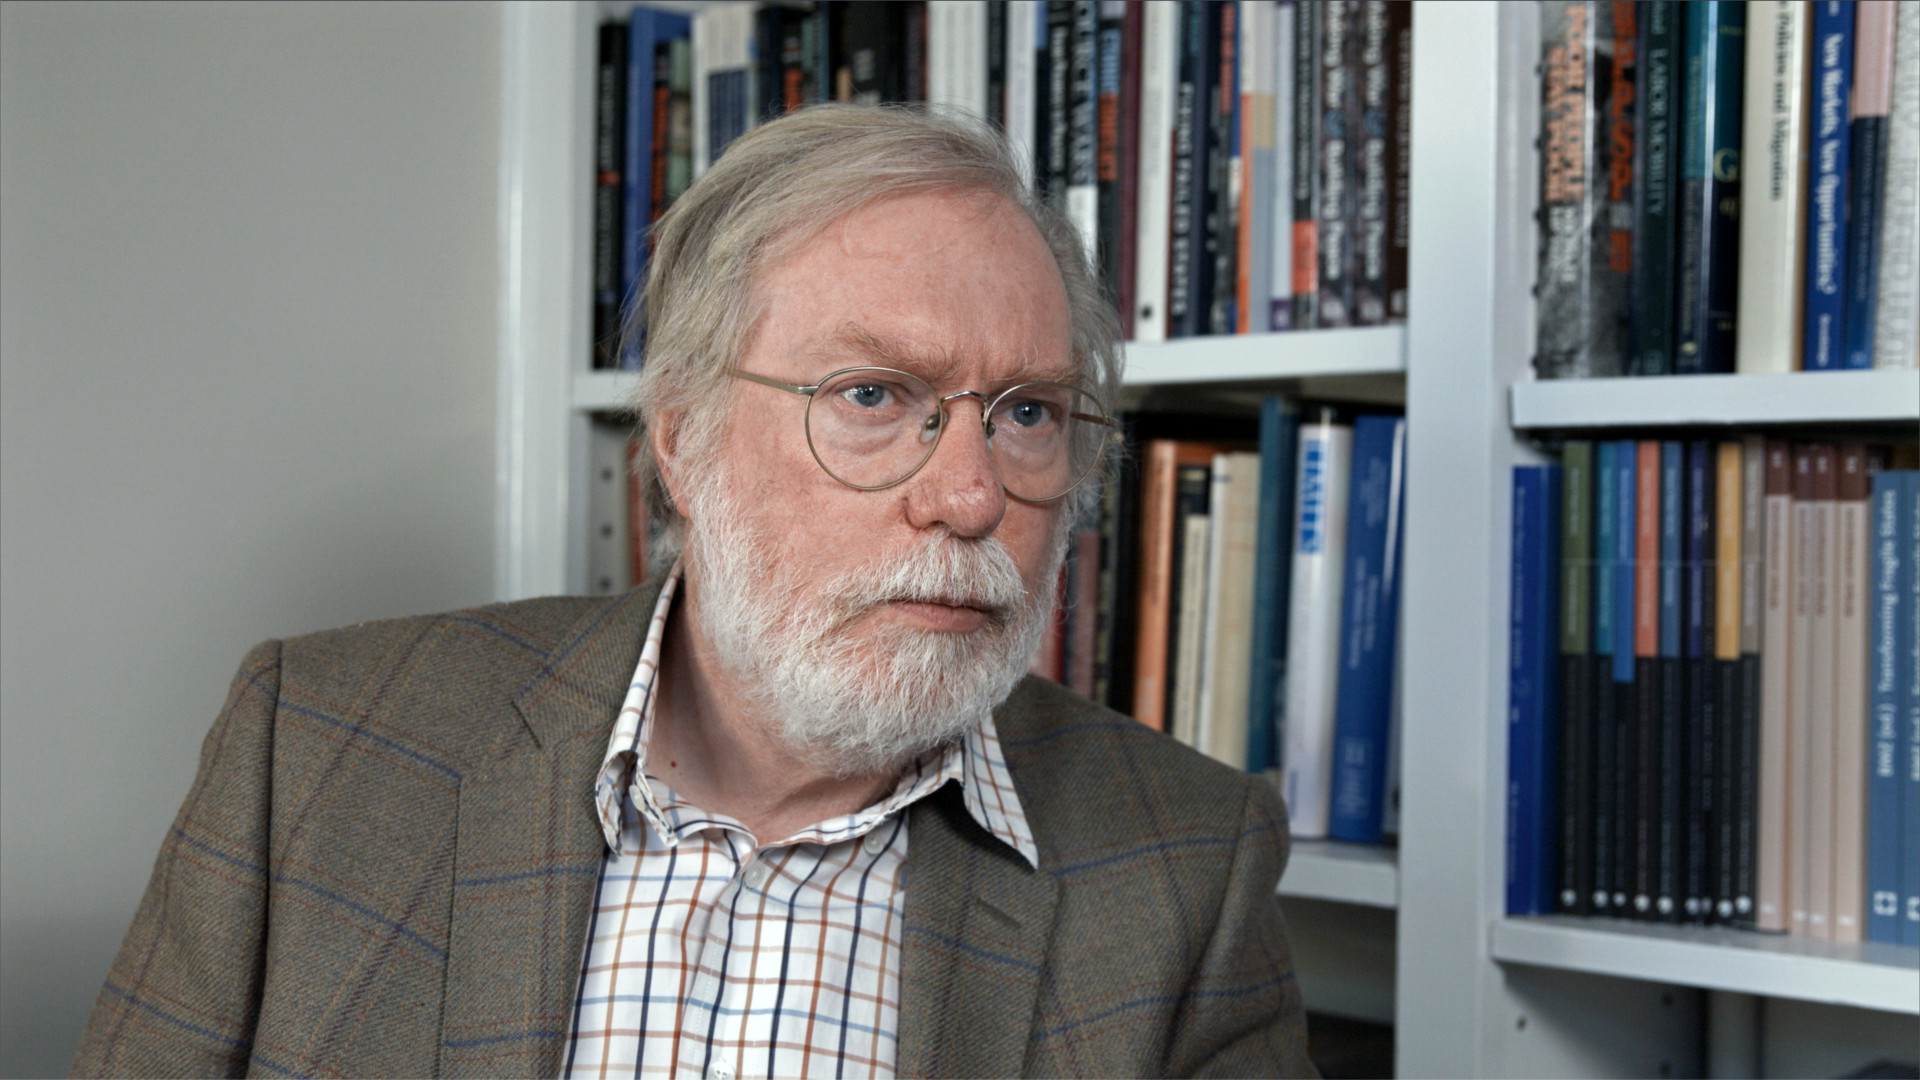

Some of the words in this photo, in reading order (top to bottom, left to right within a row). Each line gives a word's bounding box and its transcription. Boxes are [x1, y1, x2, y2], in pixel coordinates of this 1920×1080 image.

[1565, 4, 1587, 87] POOR
[1775, 12, 1791, 76] Policies
[1823, 33, 1844, 67] New
[1326, 66, 1346, 107] War
[1366, 64, 1386, 106] War
[1648, 48, 1668, 116] LABOR
[1773, 80, 1790, 113] and
[1818, 69, 1842, 138] Markets,
[1176, 82, 1193, 155] FIXING
[1564, 93, 1586, 201] PEOPLE
[1322, 139, 1345, 218] Building
[1362, 139, 1385, 218] Building
[1545, 120, 1565, 201] POOR
[1647, 119, 1667, 216] MOBILITY
[1767, 117, 1789, 201] Migration
[1820, 139, 1841, 172] New
[1175, 158, 1191, 233] FAILED
[1326, 220, 1345, 280] Peace
[1365, 220, 1385, 280] Peace
[1815, 174, 1839, 295] Opportunities?
[1172, 238, 1189, 316] STATES
[1880, 490, 1897, 538] States
[1878, 540, 1900, 592] Fragile
[1878, 593, 1899, 692] Transforming
[1877, 741, 1894, 777] BMZ
